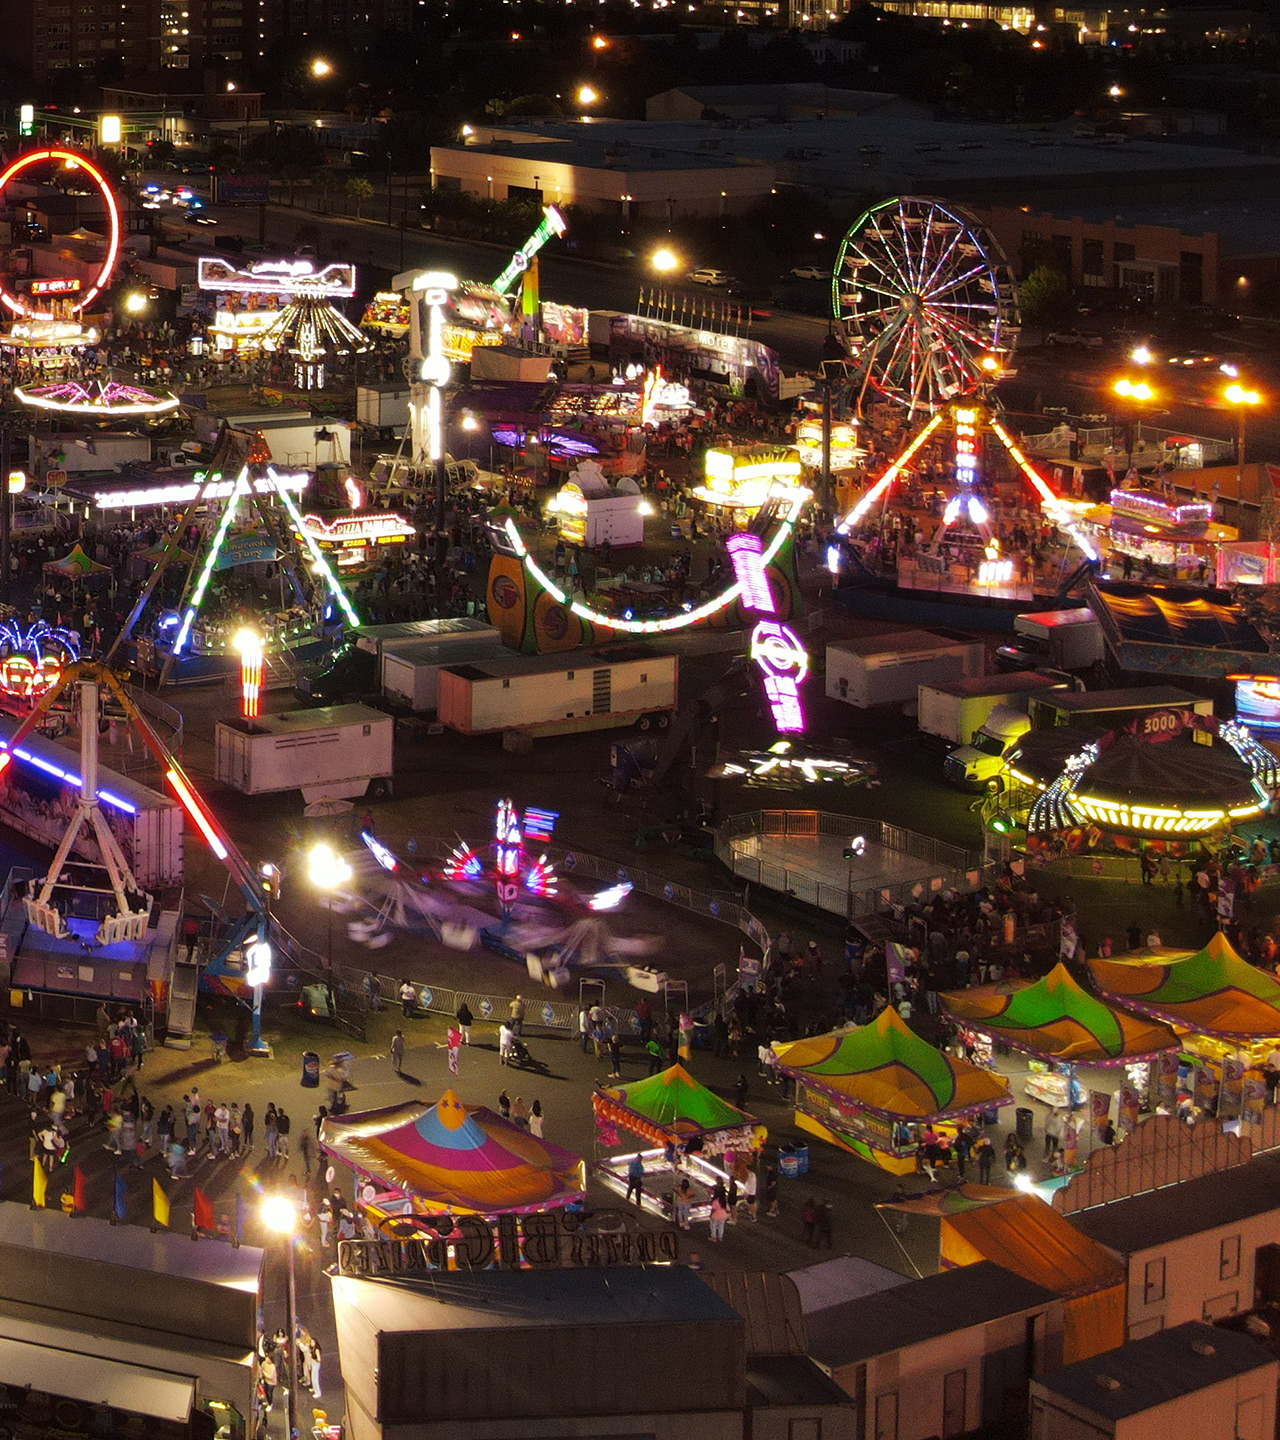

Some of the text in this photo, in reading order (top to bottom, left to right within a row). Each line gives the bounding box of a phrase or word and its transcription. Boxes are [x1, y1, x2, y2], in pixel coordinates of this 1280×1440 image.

[699, 332, 734, 352] MOTEL
[337, 522, 362, 535] PIZZA
[1144, 714, 1176, 734] 3000
